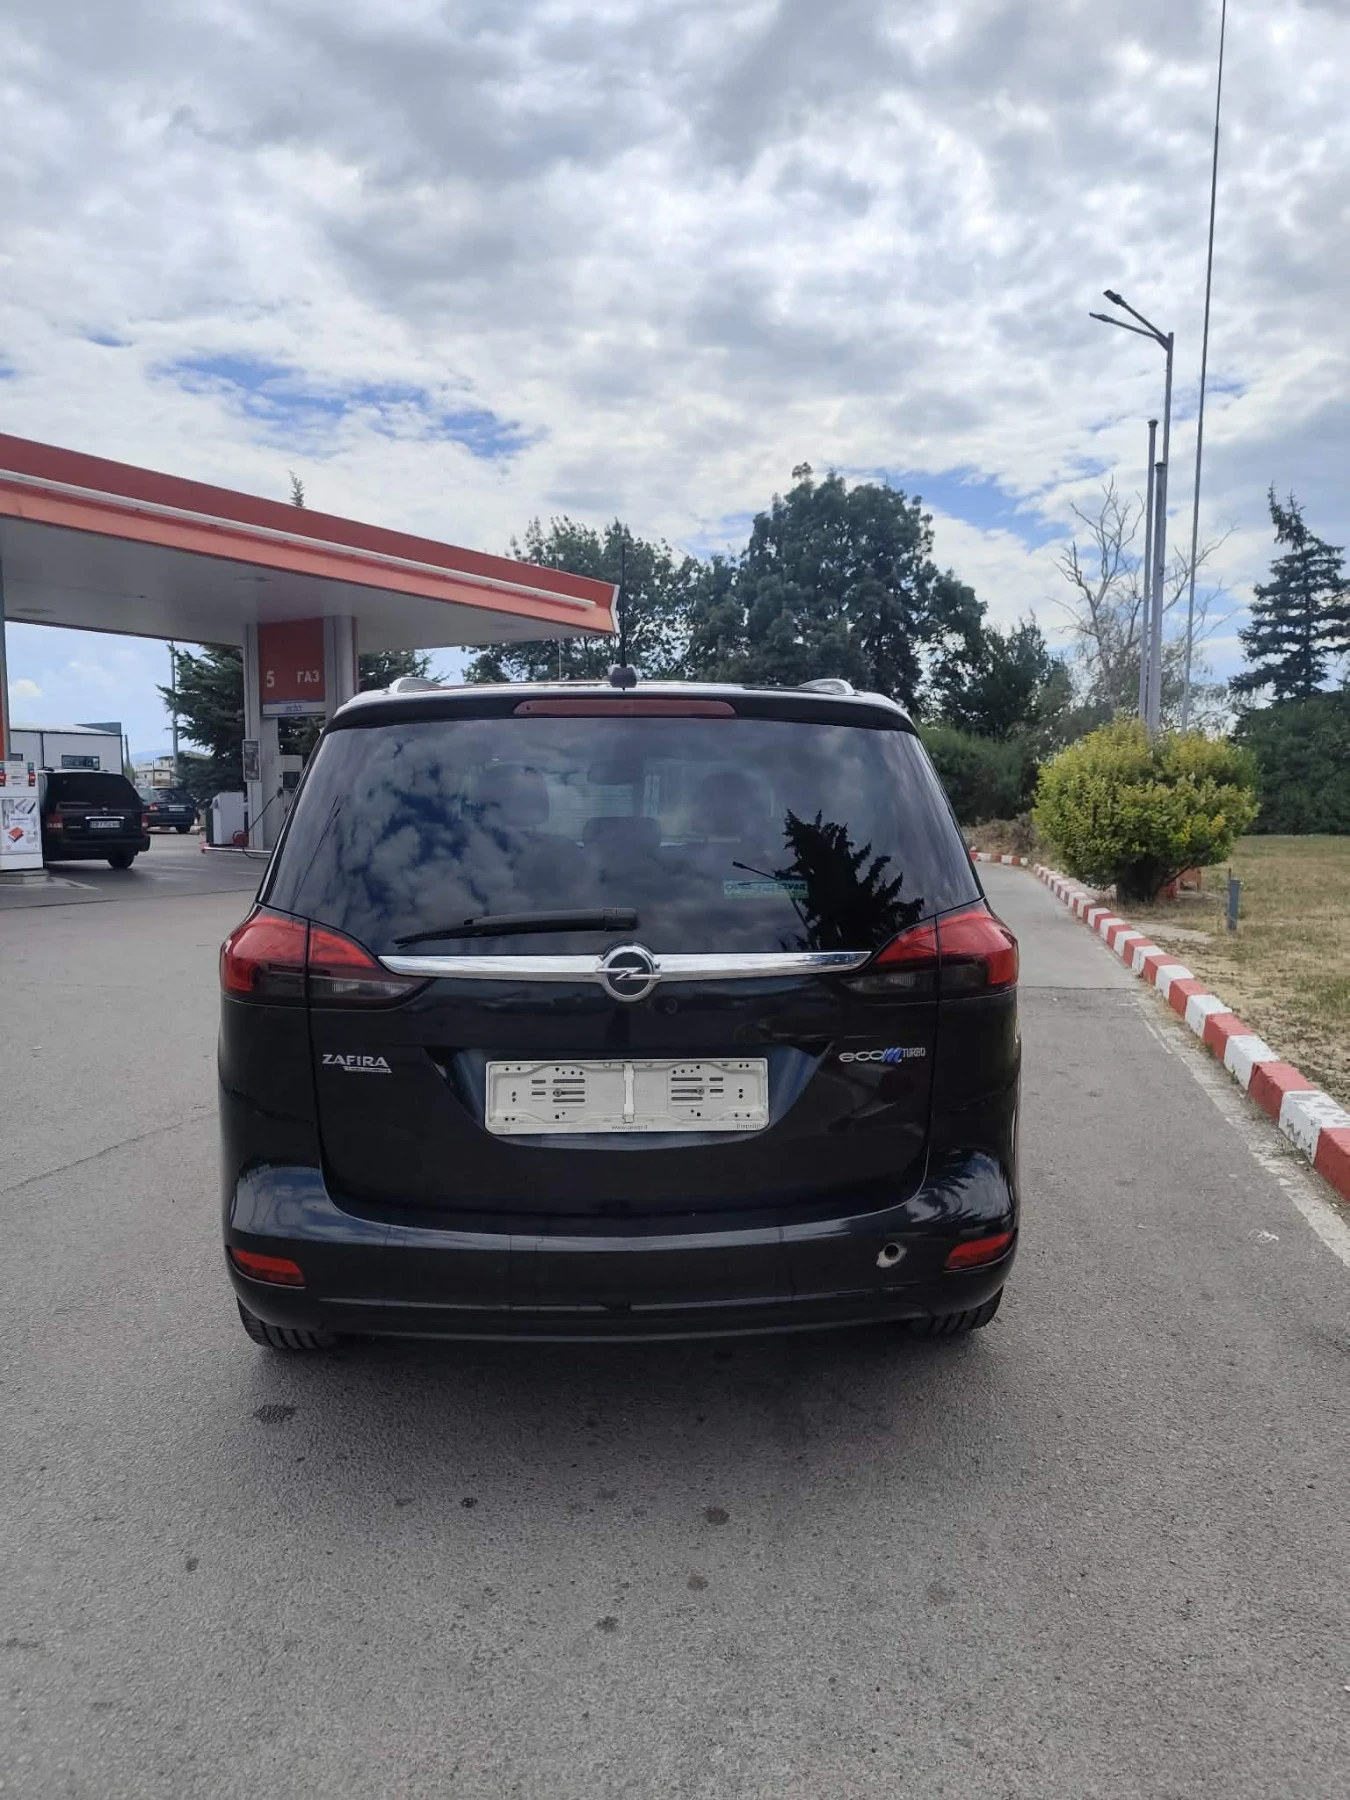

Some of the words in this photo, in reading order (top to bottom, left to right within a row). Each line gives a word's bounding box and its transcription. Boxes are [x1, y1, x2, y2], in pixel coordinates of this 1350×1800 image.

[266, 670, 275, 688] 5
[296, 669, 320, 683] ГАЗ
[322, 1054, 389, 1068] ZAFIRA
